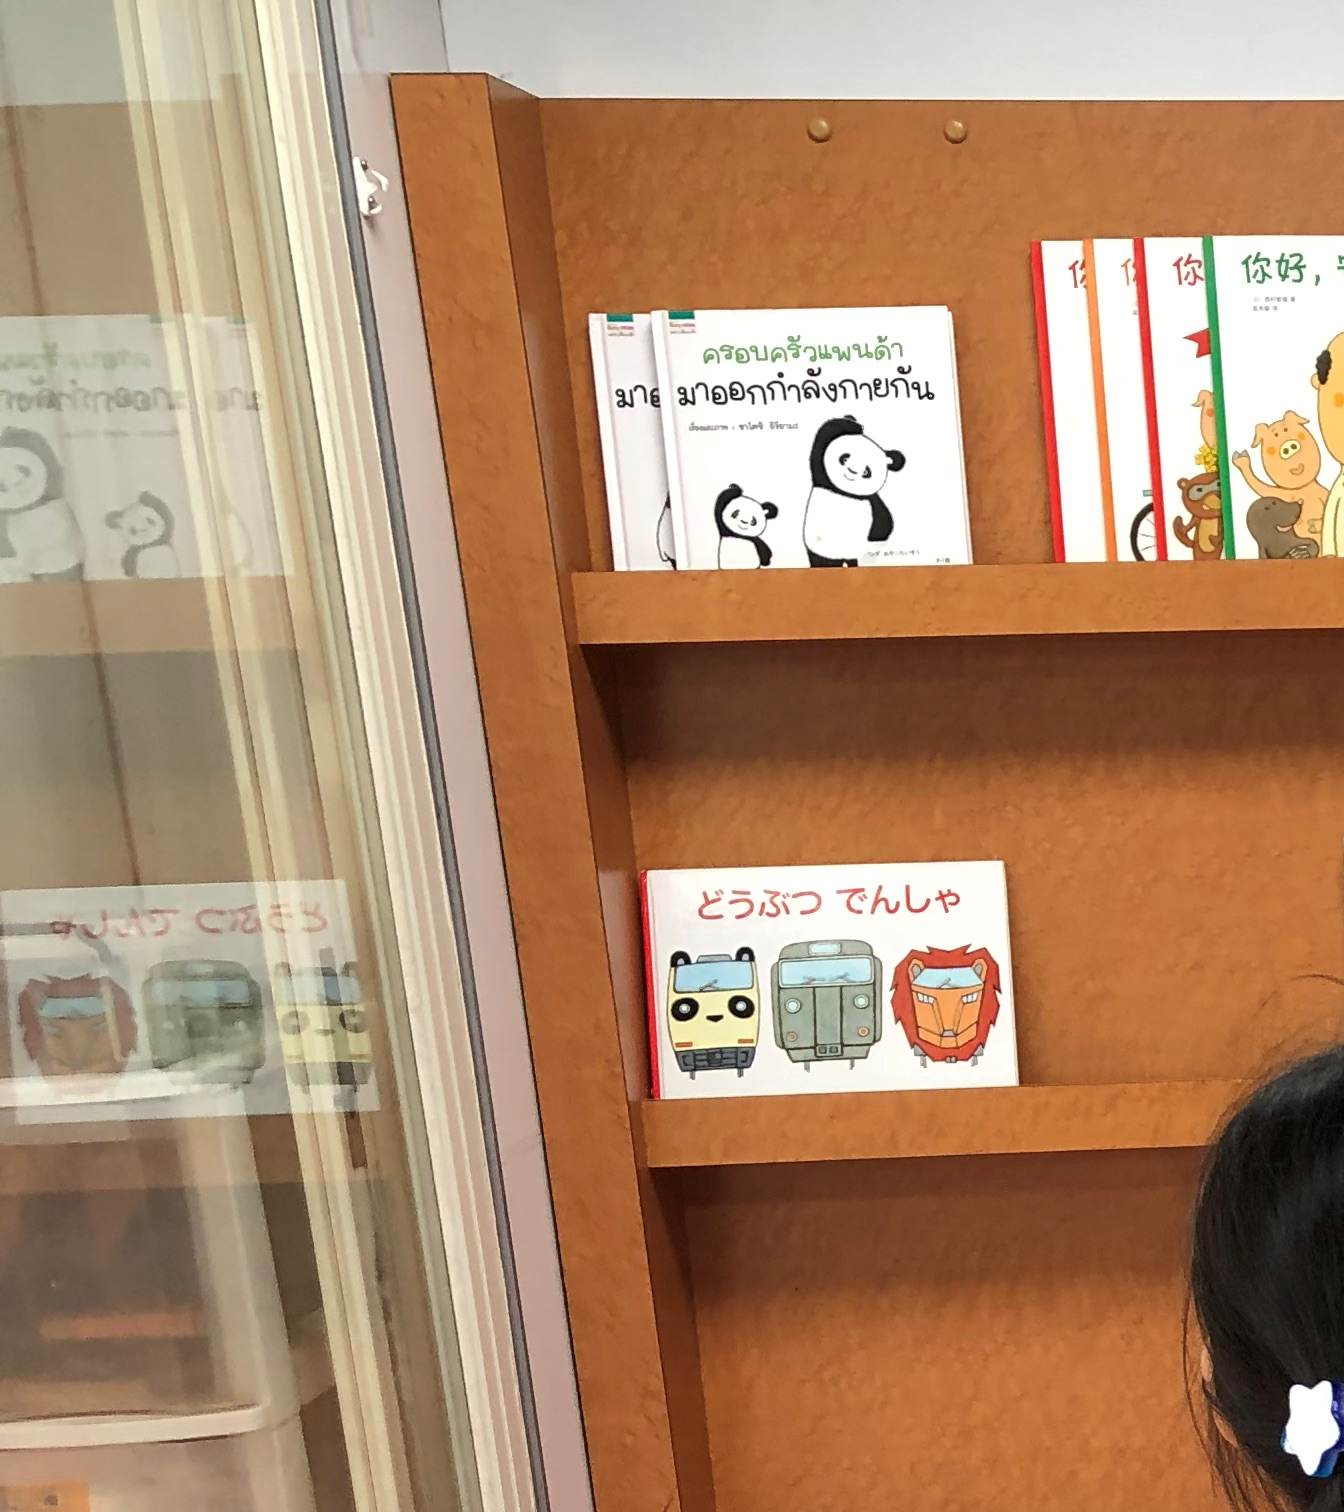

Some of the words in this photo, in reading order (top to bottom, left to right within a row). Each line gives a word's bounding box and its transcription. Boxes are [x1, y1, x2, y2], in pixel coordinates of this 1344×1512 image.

[702, 334, 905, 366] ครอบครัวแพนด้า
[677, 366, 936, 408] มาออกกำลังกายกัน
[697, 888, 822, 921] どうぶつ
[836, 882, 961, 916] でんしゃ
